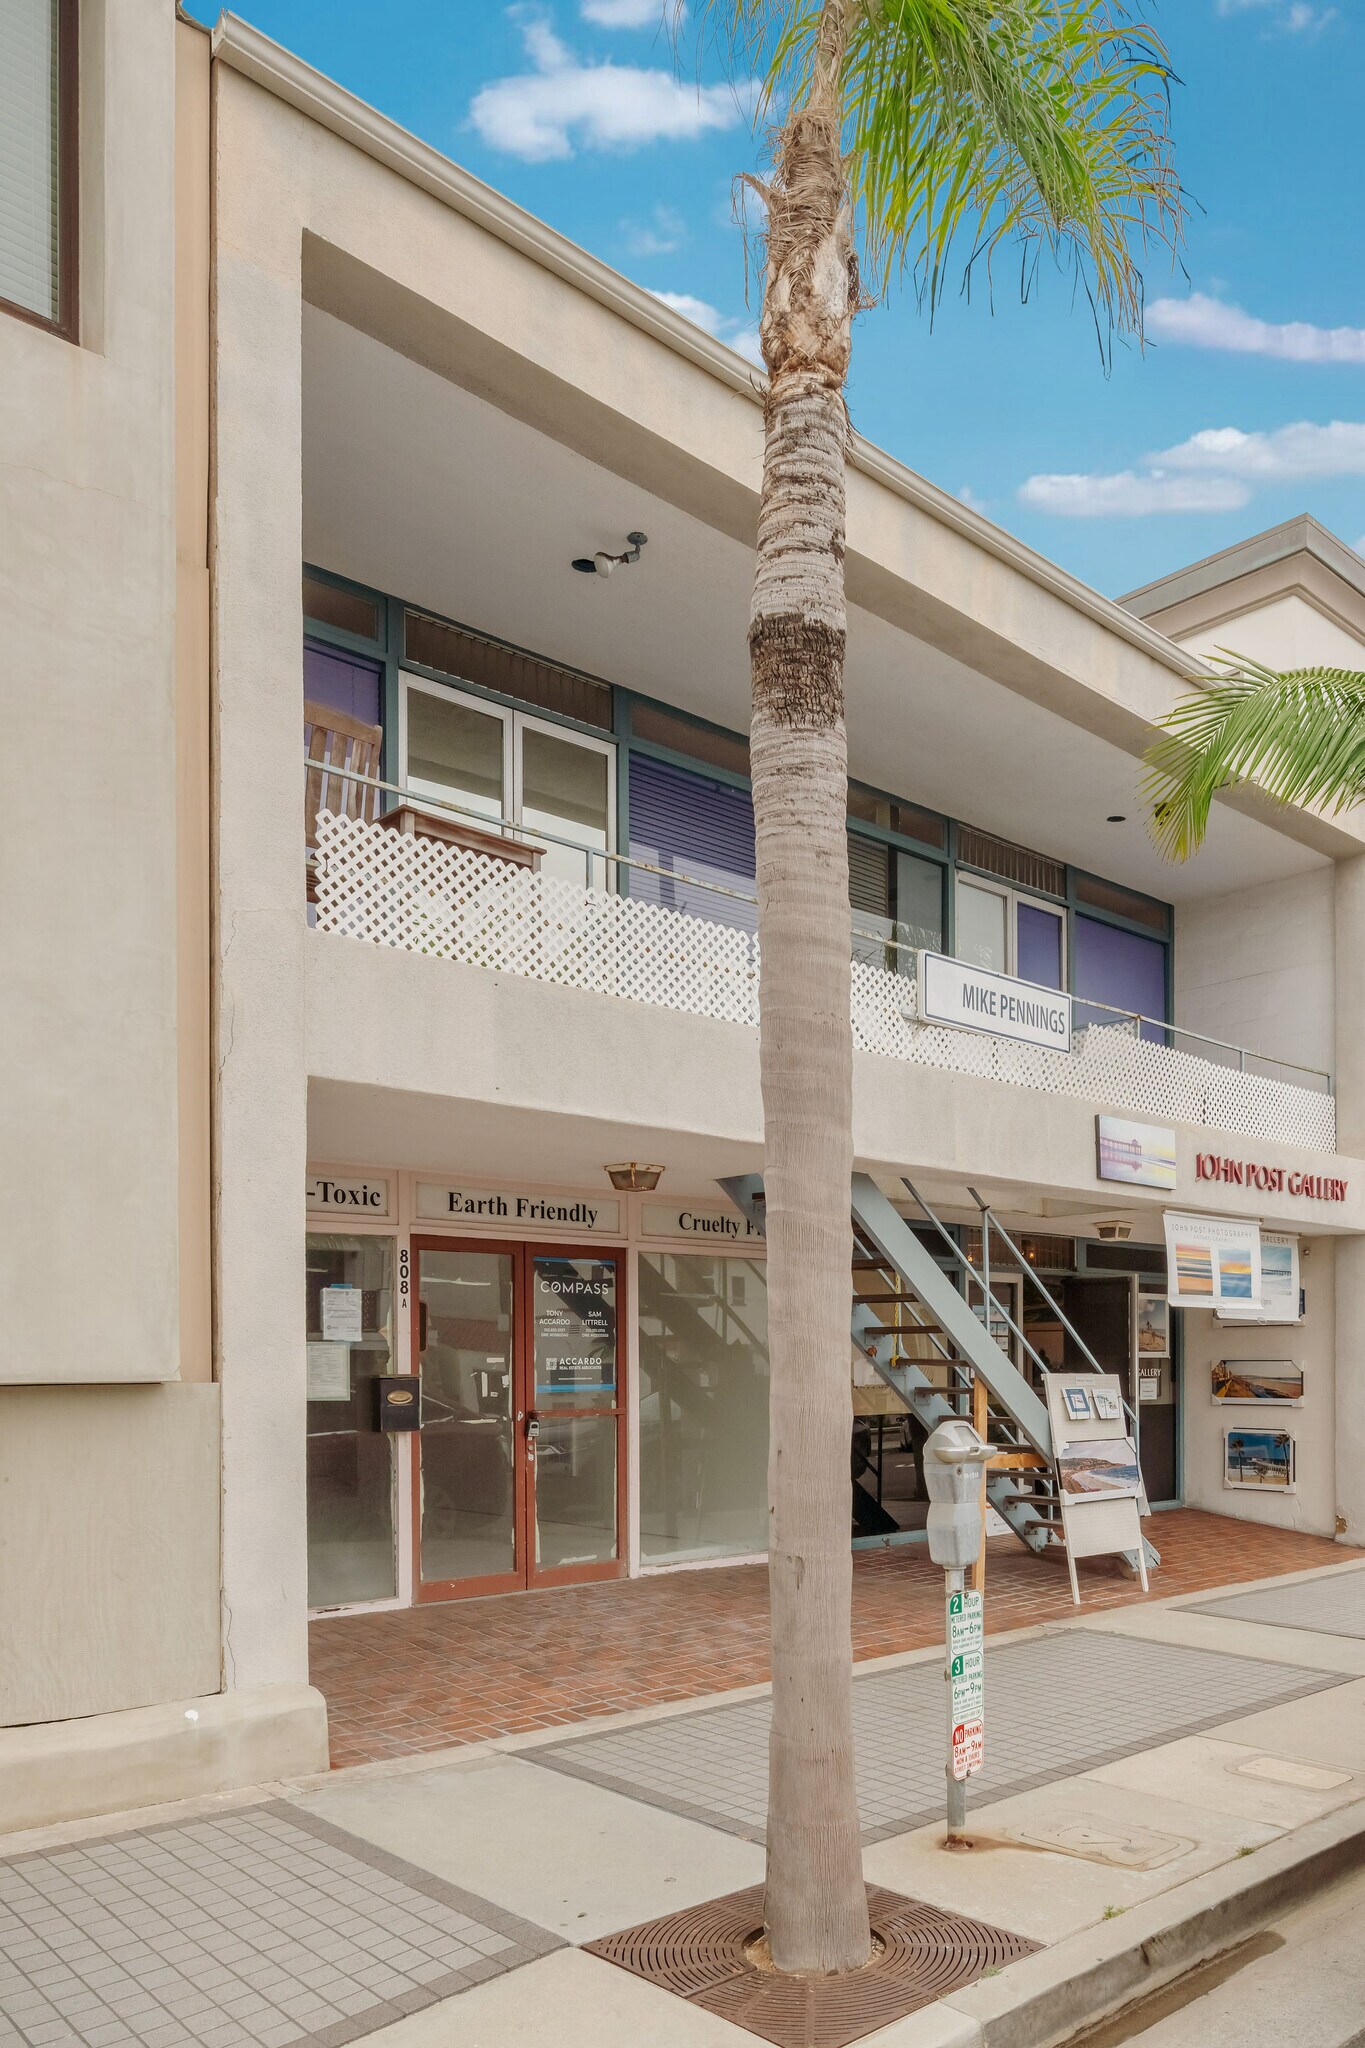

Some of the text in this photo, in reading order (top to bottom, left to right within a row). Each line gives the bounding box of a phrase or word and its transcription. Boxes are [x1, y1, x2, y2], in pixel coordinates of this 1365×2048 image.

[962, 983, 1065, 1034] MIKE PENNINGS
[1195, 1152, 1348, 1202] JOHN POST GALLERY
[448, 1192, 598, 1228] Earth Friendly
[678, 1212, 740, 1238] Cruelty
[1171, 1223, 1252, 1238] JOHN POST PHOTOGRAPHY
[1262, 1234, 1289, 1244] GALLERY
[400, 1249, 408, 1294] 808
[540, 1280, 608, 1295] COMPASS
[953, 1597, 959, 1612] 2
[954, 1656, 980, 1674] 3 HOUR
[956, 1725, 982, 1744] NO PARKING
